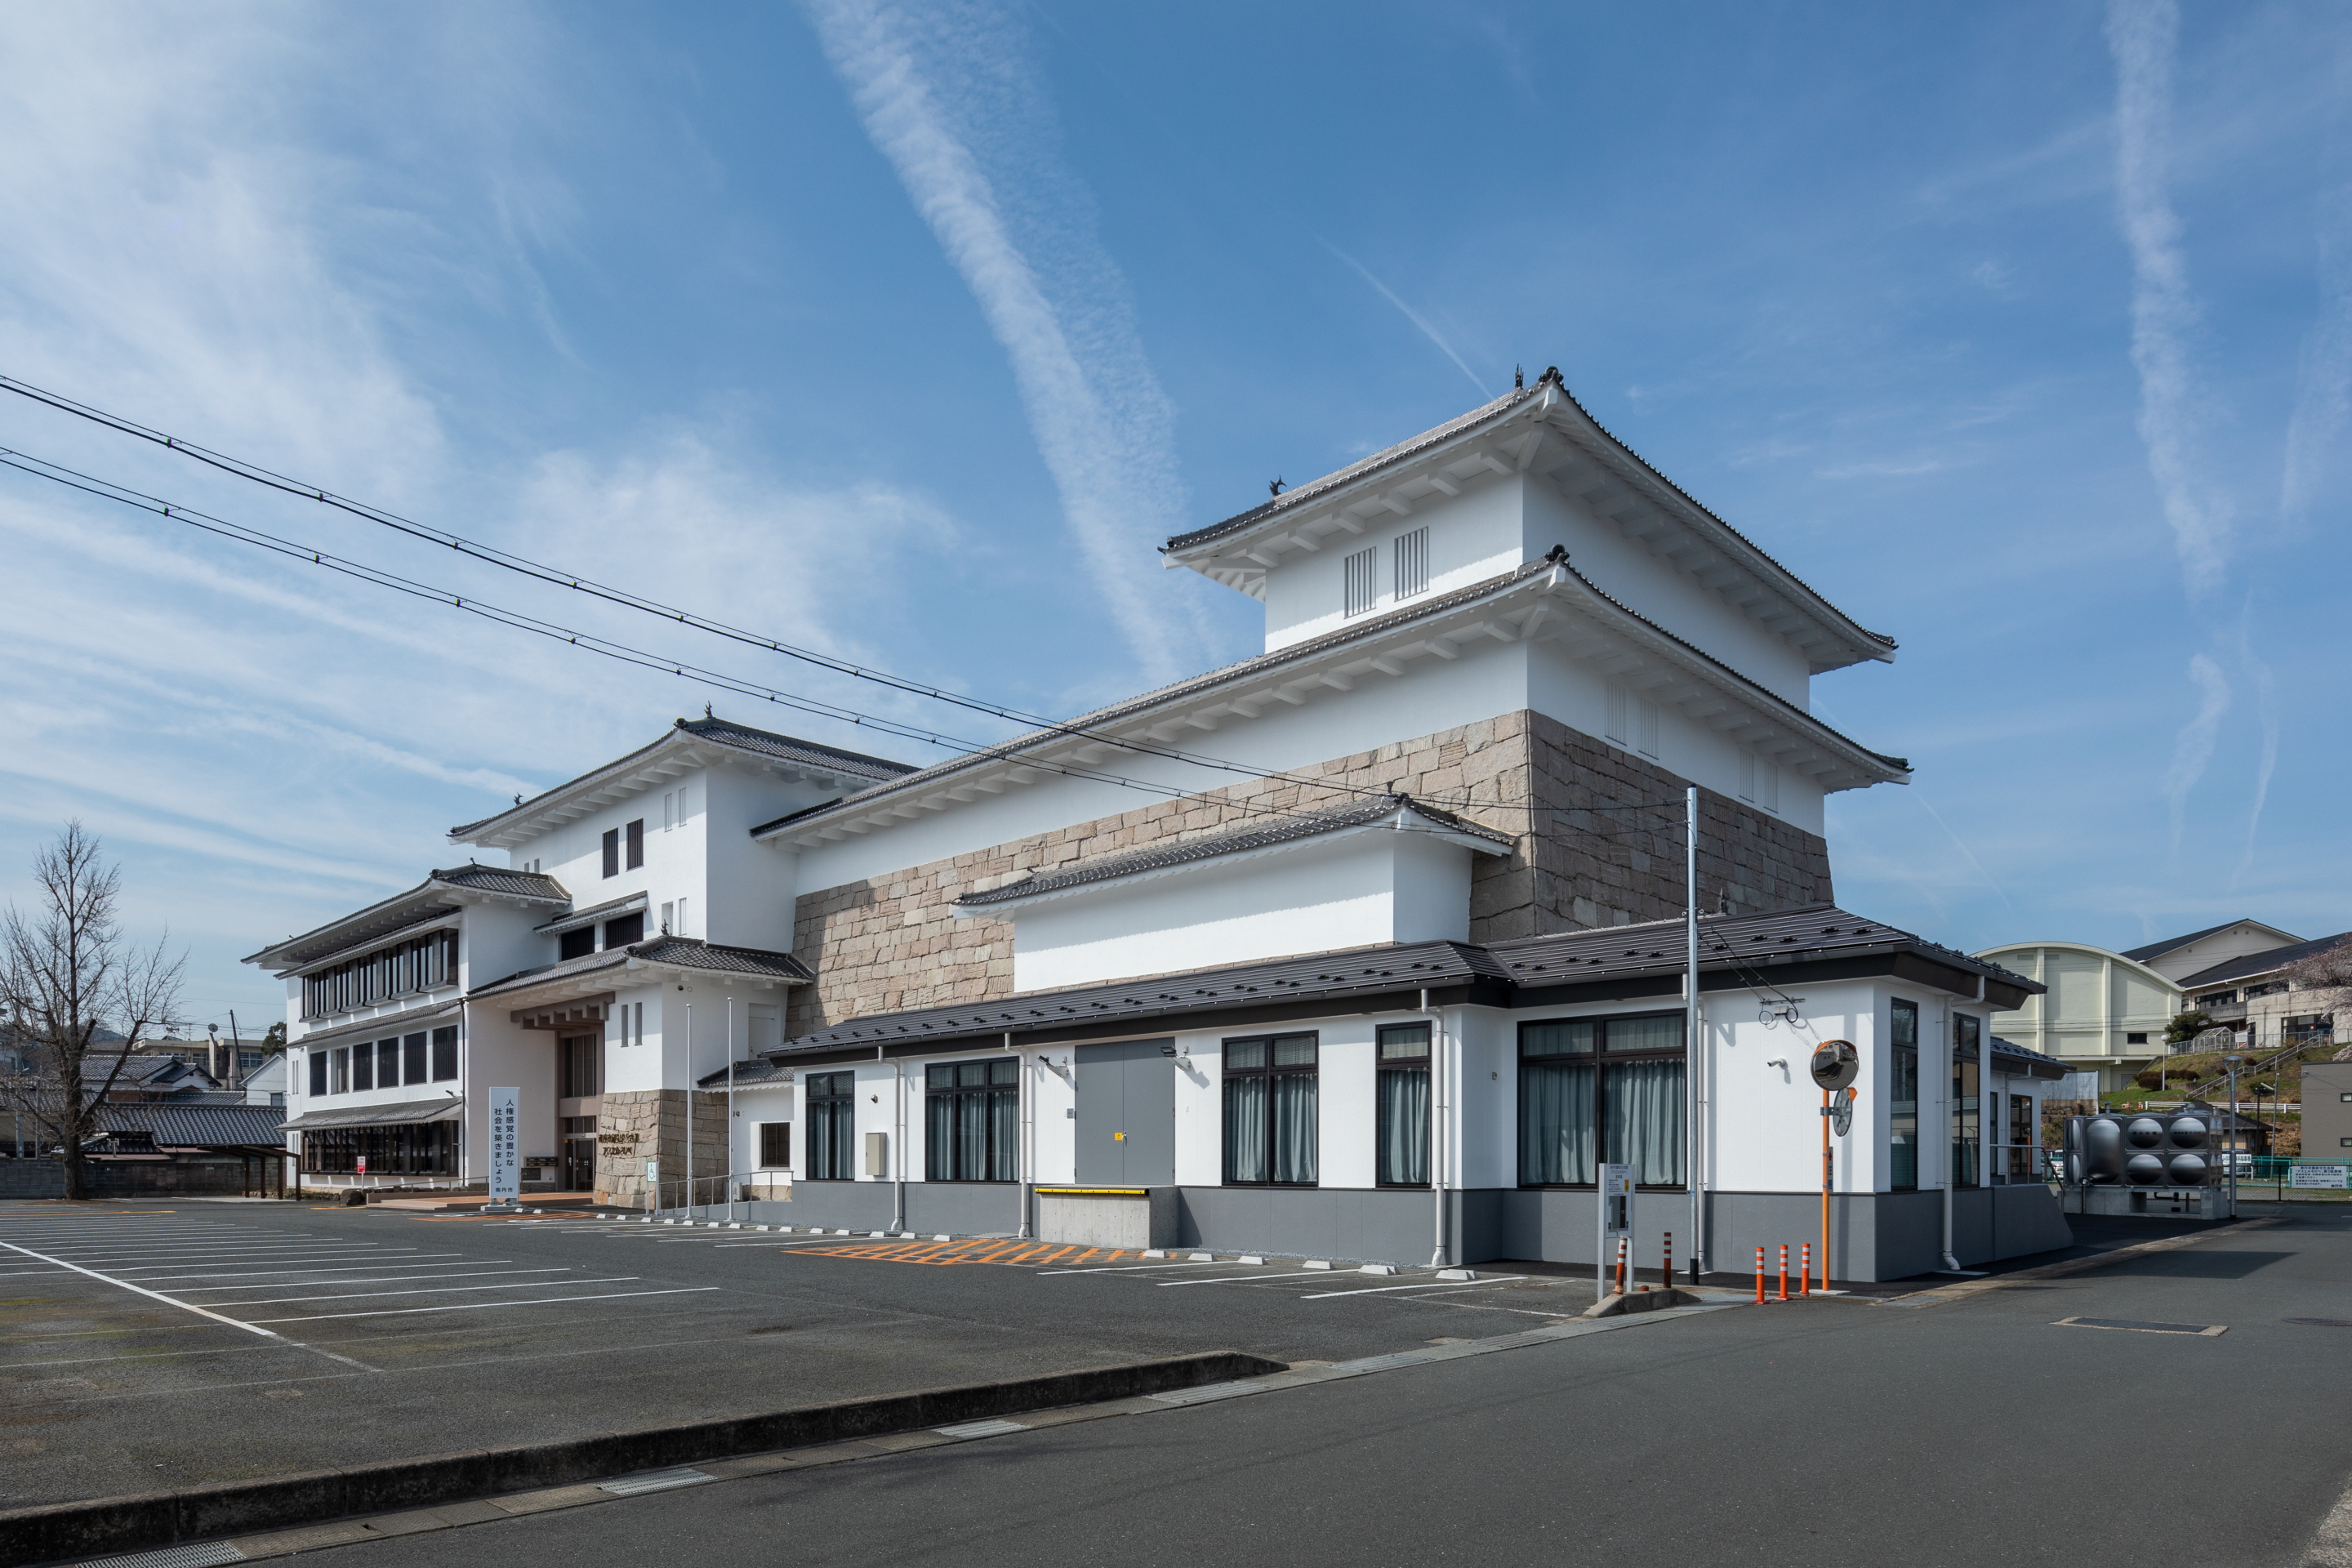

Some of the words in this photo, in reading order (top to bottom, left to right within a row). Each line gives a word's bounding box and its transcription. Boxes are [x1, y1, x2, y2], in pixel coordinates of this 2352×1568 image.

[494, 1108, 502, 1183] 社会を築きましょう
[506, 1098, 514, 1167] 人権感覚の豊かな
